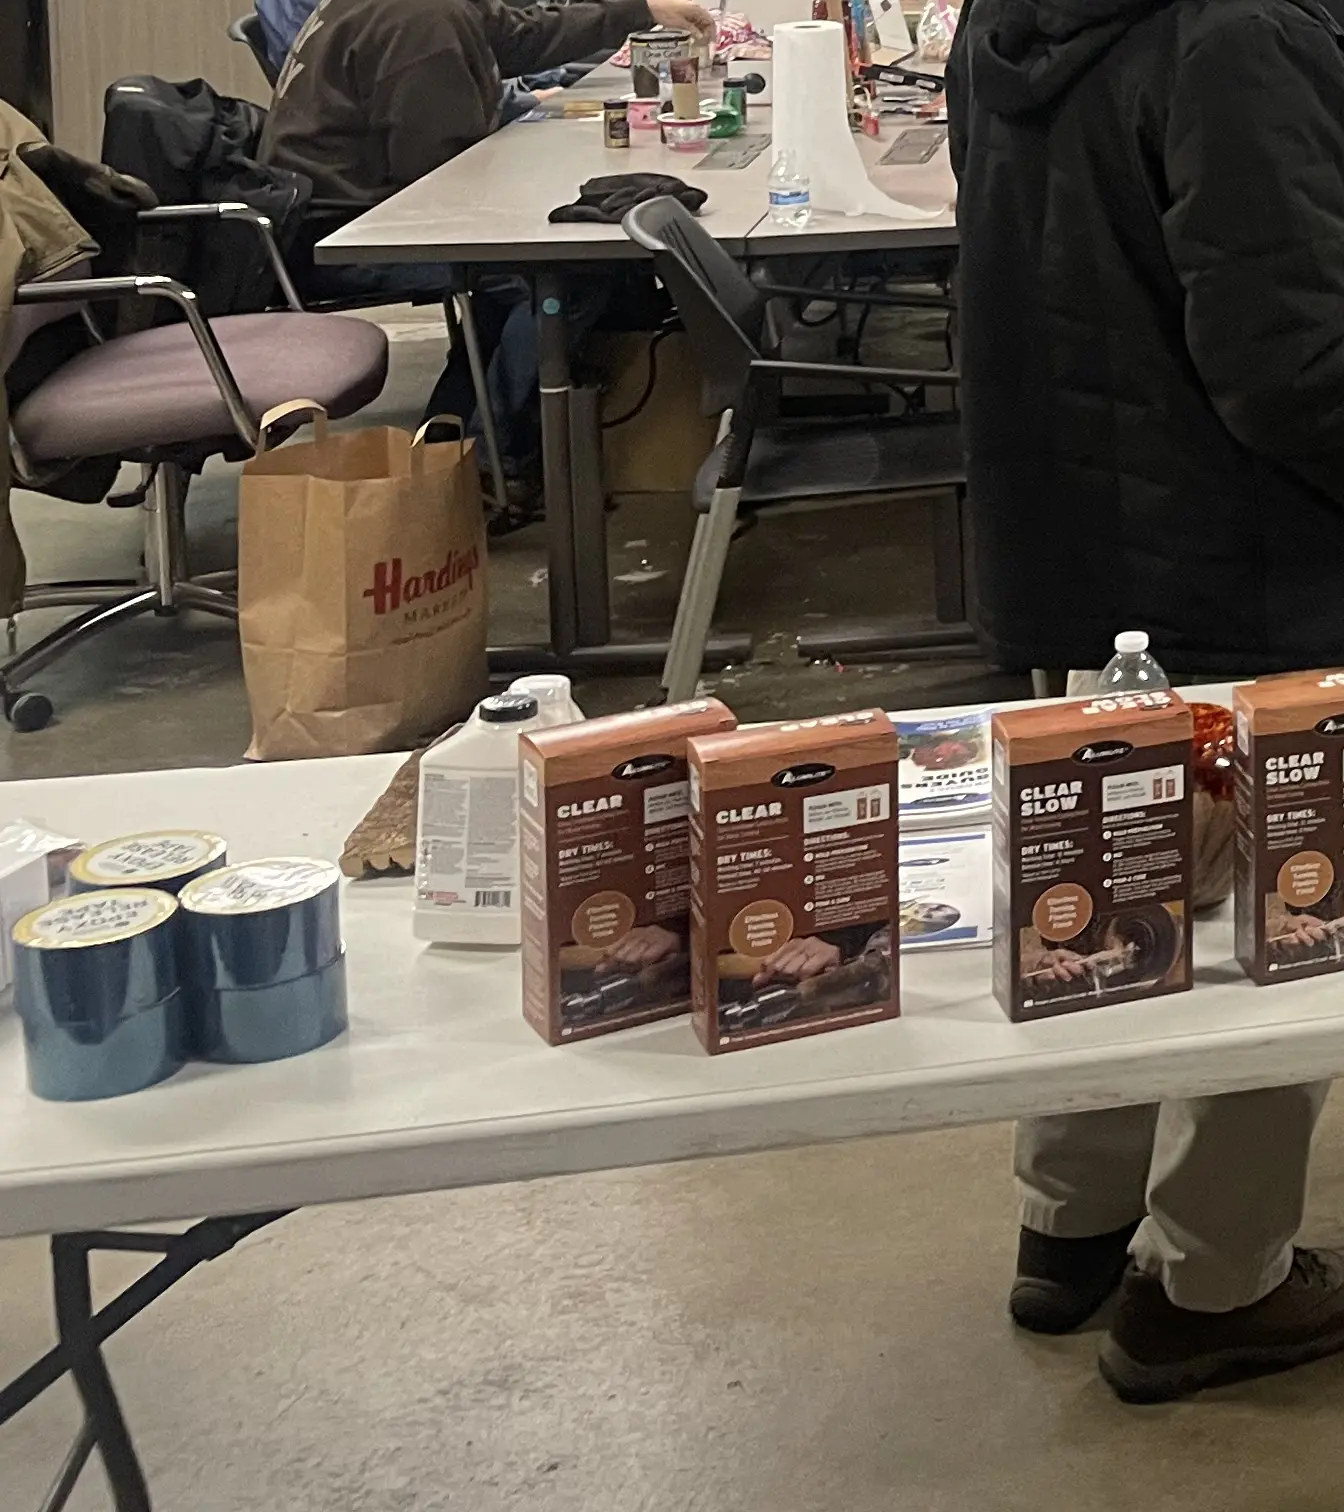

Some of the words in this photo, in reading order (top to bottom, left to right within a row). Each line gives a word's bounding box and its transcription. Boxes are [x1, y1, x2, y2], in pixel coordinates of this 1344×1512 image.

[1265, 751, 1325, 771] CLEAR
[922, 767, 988, 781] GUIDE
[1266, 765, 1321, 785] SLOW
[1020, 780, 1083, 802] CLEAR
[557, 794, 623, 819] CLEAR
[716, 802, 782, 824] CLEAR
[1021, 795, 1078, 817] SLOW
[1266, 813, 1285, 823] DRY
[1287, 808, 1316, 820] TIMES:
[717, 854, 737, 865] DRY
[740, 848, 772, 862] TIMES:
[1021, 844, 1041, 856] DRY
[1043, 839, 1074, 853] TIMES:
[56, 910, 138, 934] EPOXY
